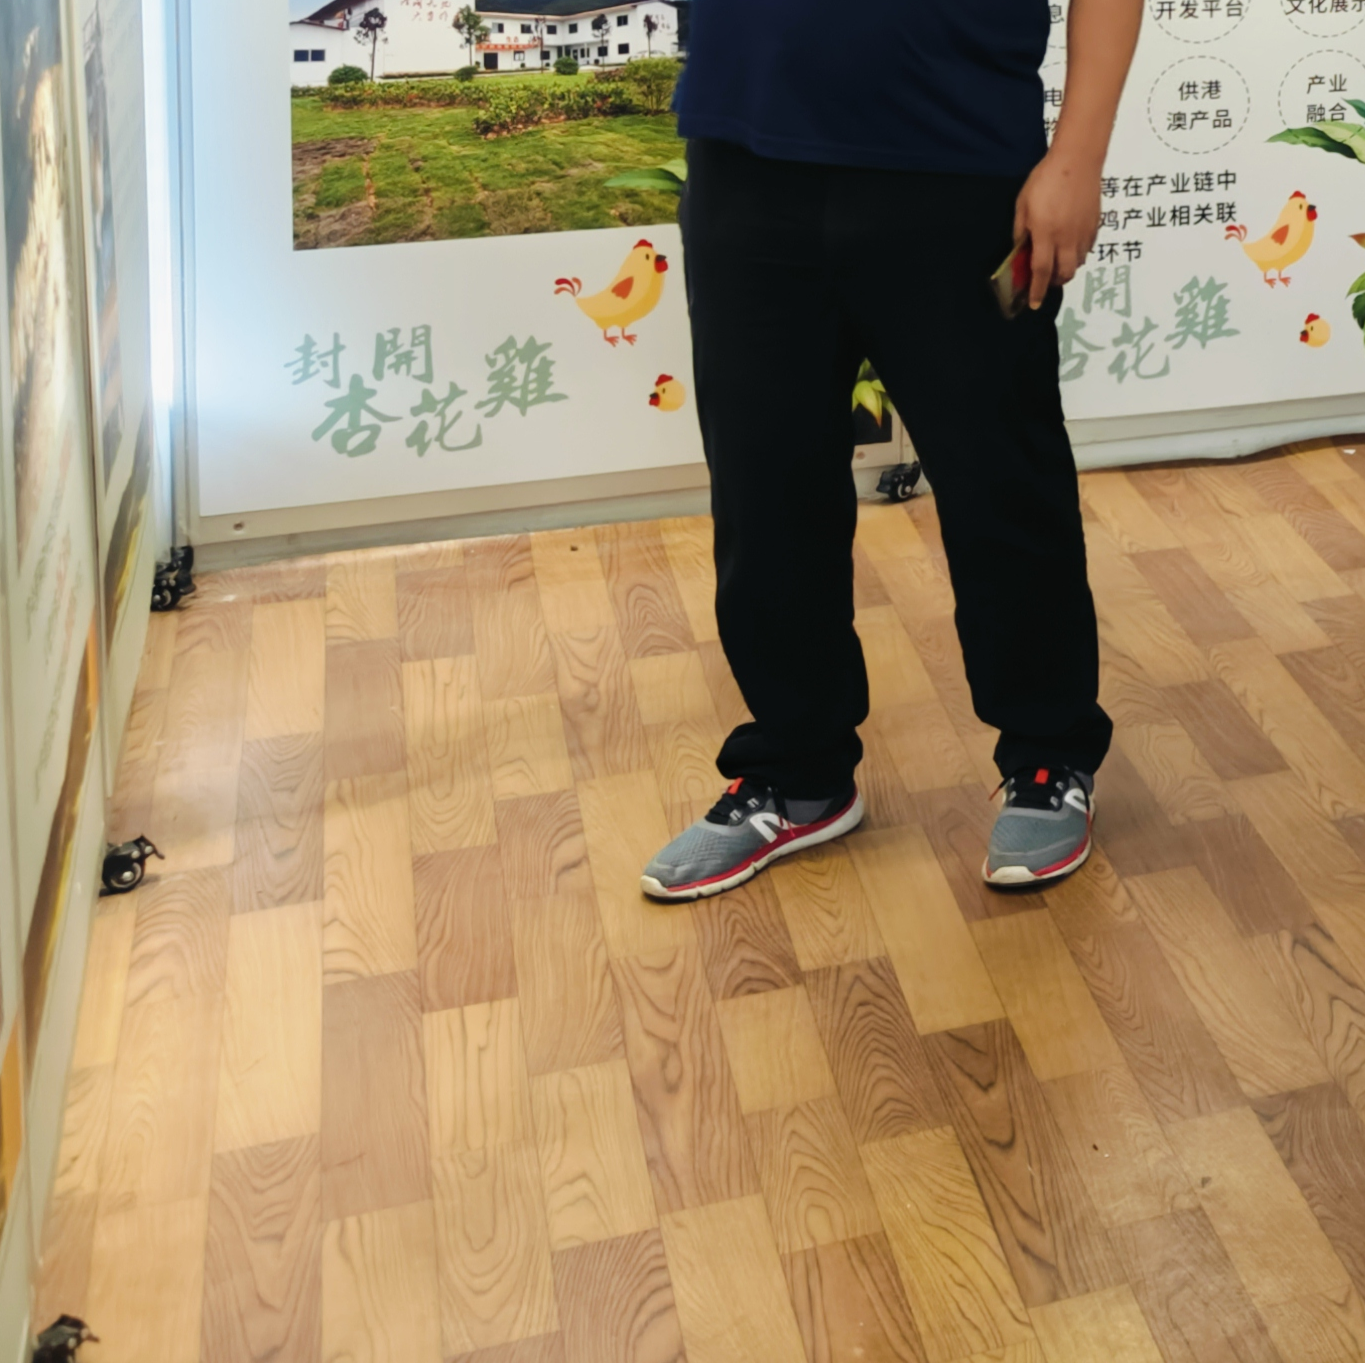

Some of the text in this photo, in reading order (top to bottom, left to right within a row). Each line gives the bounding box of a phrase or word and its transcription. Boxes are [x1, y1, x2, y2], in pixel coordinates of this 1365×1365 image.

[1177, 79, 1222, 102] 供港
[1305, 74, 1348, 94] 产业
[1166, 109, 1233, 132] 澳产品
[1305, 103, 1347, 124] 融合
[1099, 170, 1238, 200] 等在产业链中
[1098, 202, 1238, 231] 鸡产业相关联
[1088, 240, 1144, 264] 环节
